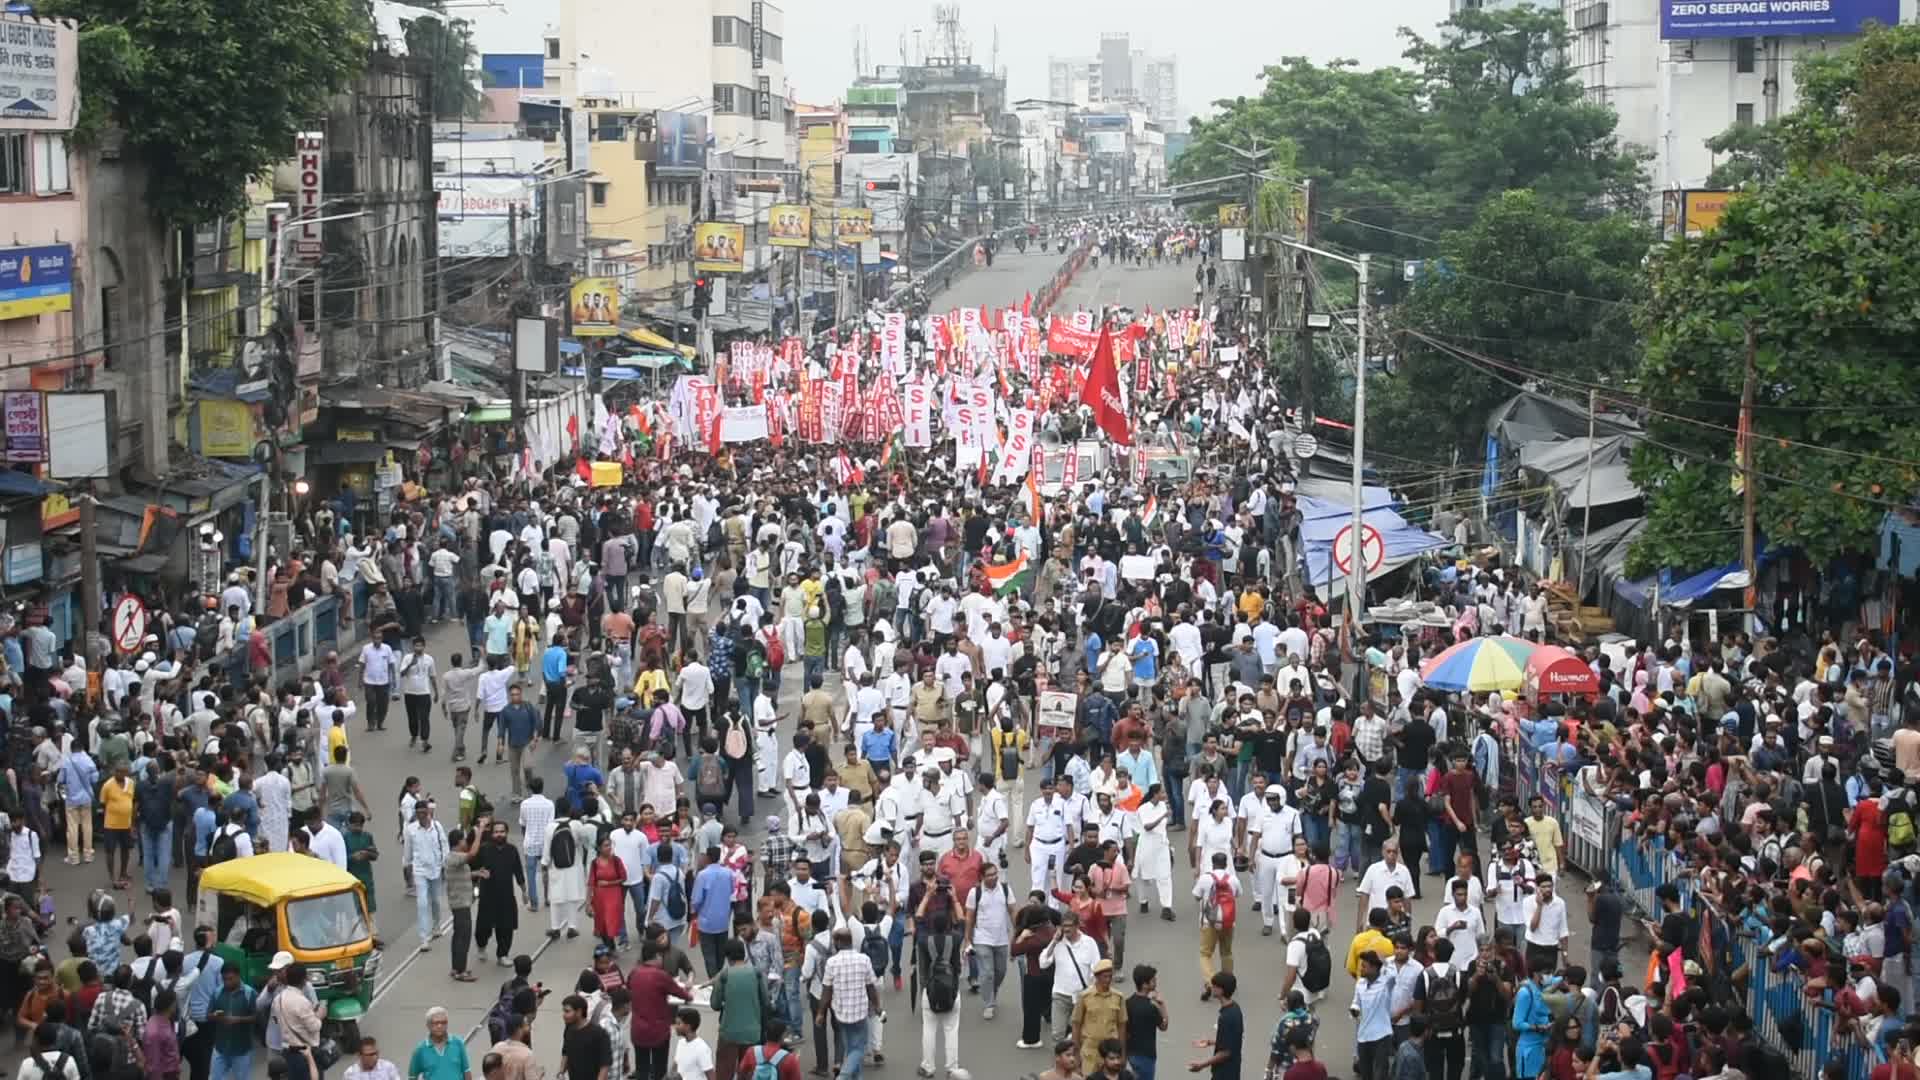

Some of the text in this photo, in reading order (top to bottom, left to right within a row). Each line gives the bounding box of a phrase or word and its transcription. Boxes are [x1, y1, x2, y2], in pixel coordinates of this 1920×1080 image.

[1671, 0, 1830, 16] ZERO SEEPAGE WORRIES
[8, 24, 32, 47] GUEST
[32, 27, 56, 48] HOUSE
[302, 154, 318, 239] HOTEL
[910, 388, 924, 444] SFI
